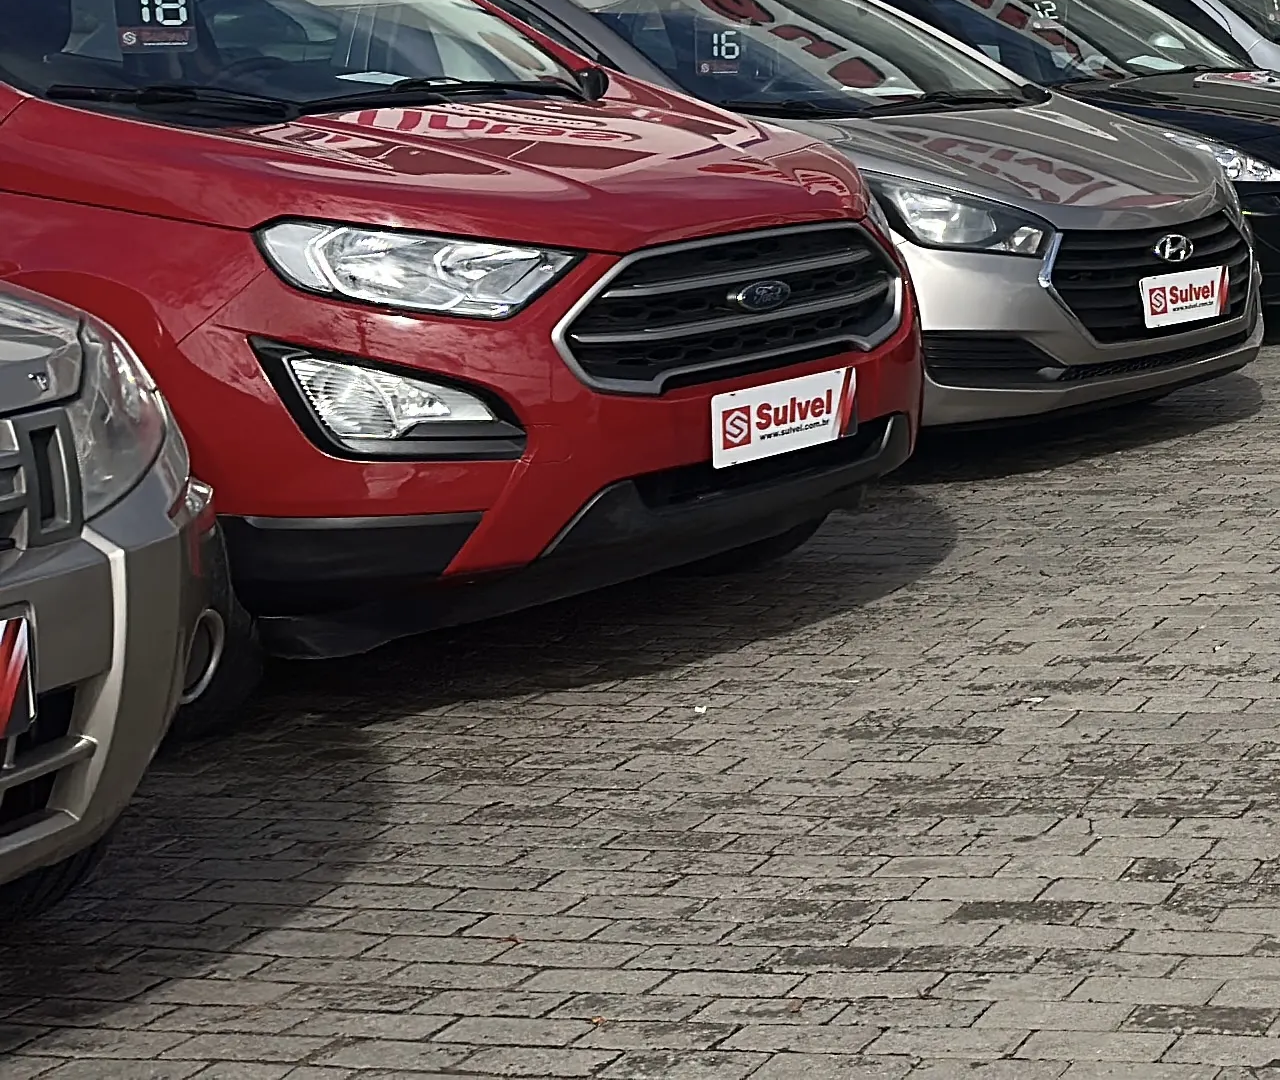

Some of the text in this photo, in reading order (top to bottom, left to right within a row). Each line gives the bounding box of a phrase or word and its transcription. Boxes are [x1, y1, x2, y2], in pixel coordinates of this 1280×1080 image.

[1034, 1, 1059, 20] 12
[713, 31, 740, 59] 16
[1169, 280, 1215, 304] Sulvel
[756, 389, 833, 430] Sulvel
[759, 419, 830, 440] www.sulvel.com.br
